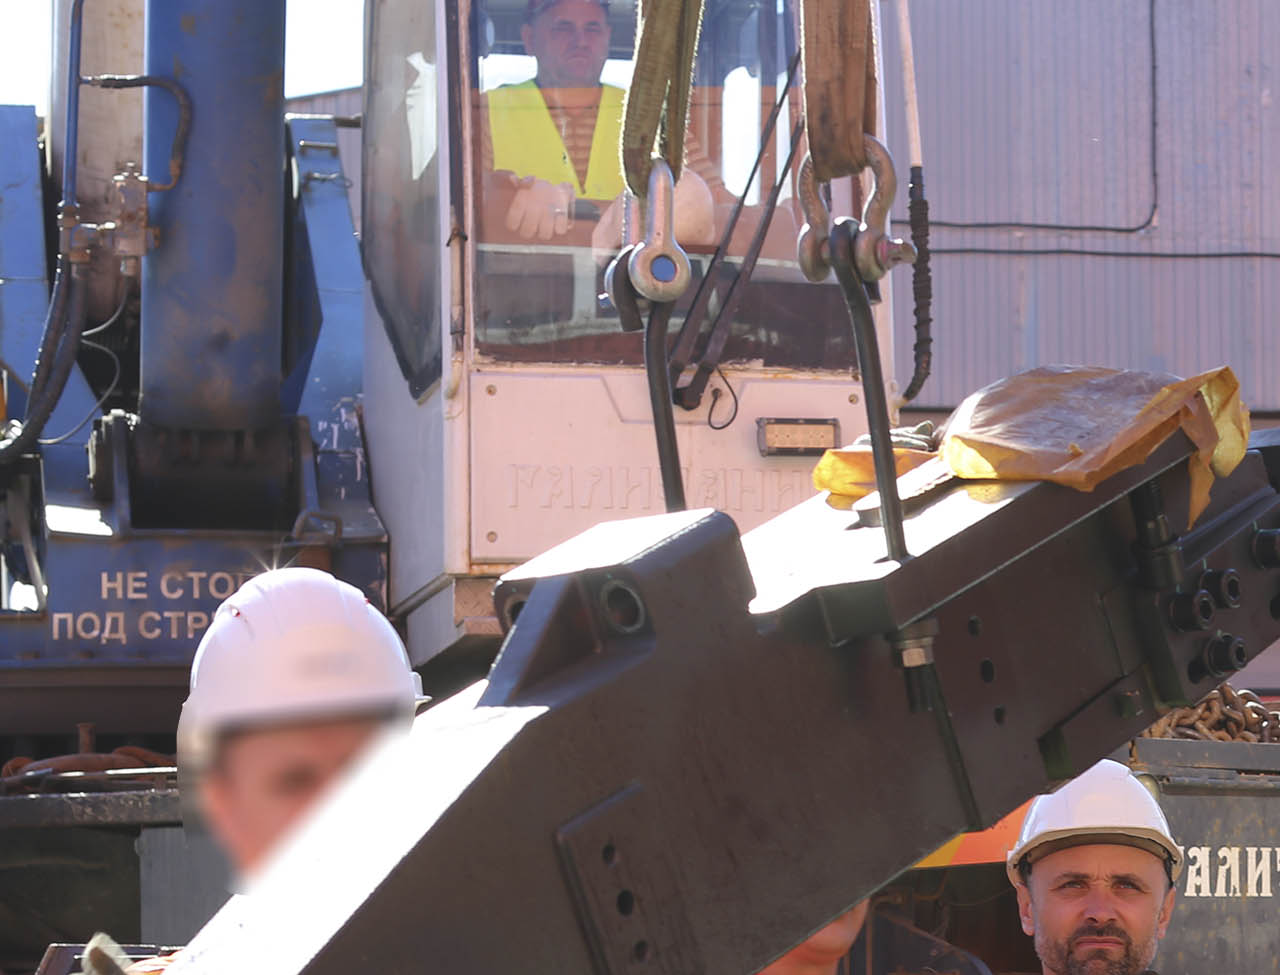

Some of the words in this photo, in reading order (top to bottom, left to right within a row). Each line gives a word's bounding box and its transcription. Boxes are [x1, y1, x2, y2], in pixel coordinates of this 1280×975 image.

[101, 572, 148, 599] НЕ
[52, 612, 127, 644] ПОД
[138, 611, 216, 639] СТР
